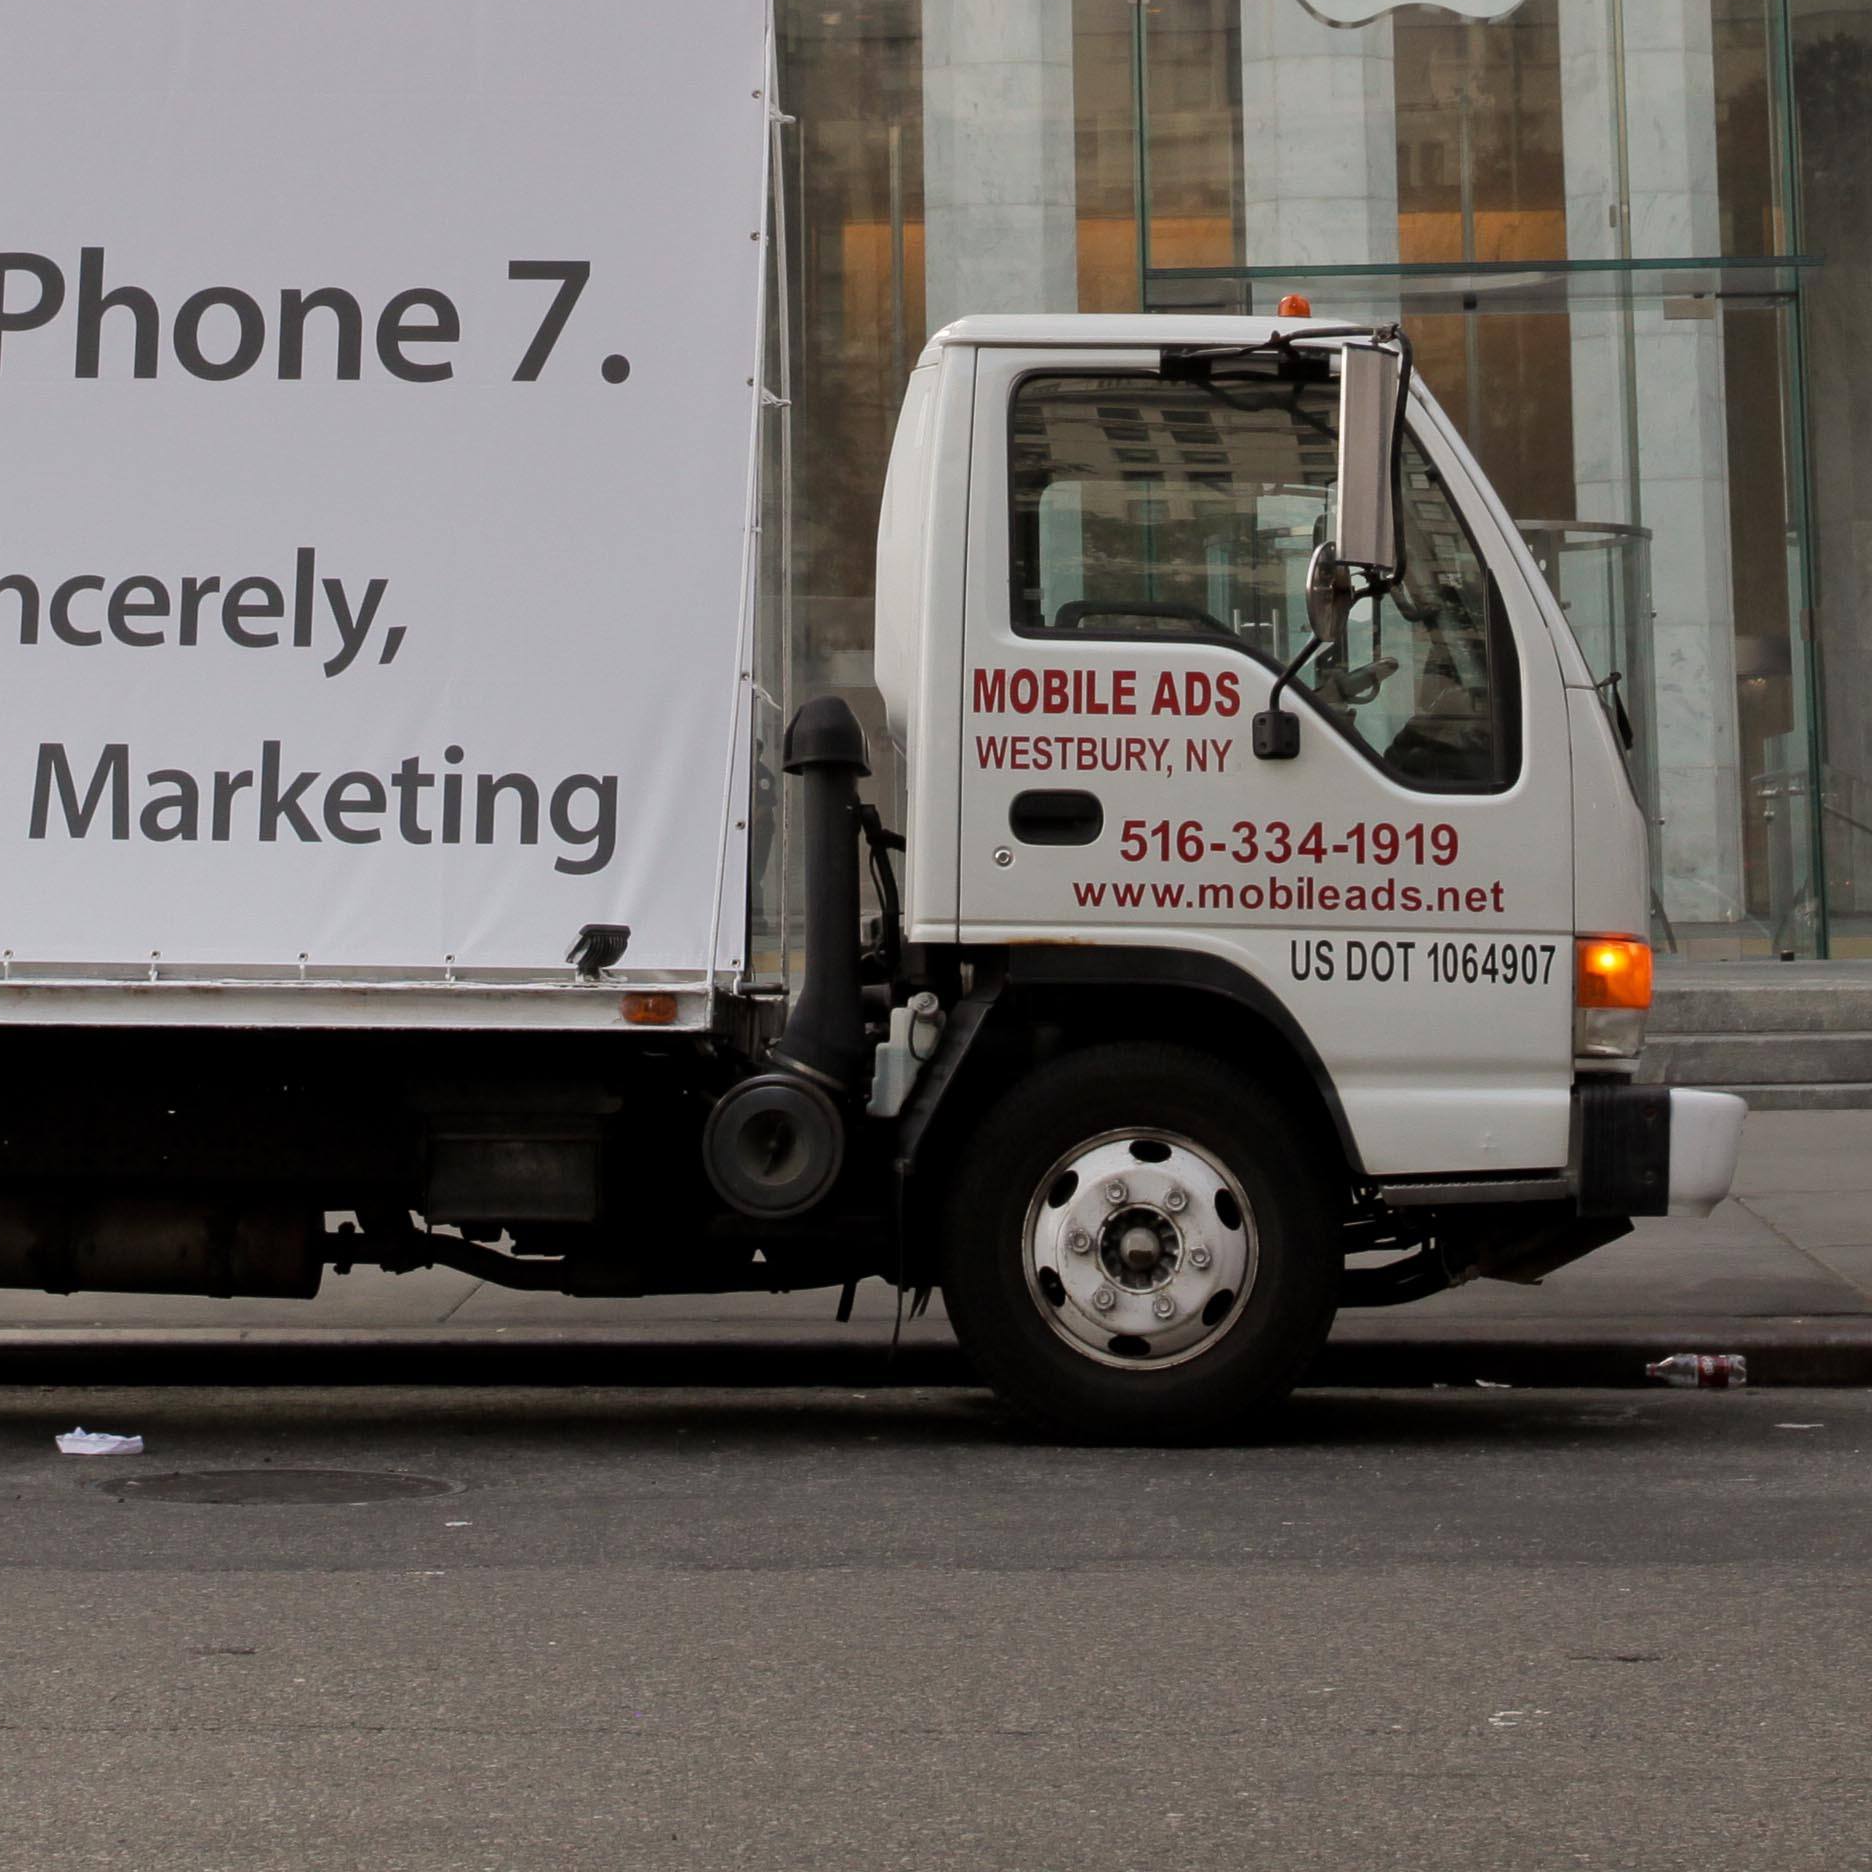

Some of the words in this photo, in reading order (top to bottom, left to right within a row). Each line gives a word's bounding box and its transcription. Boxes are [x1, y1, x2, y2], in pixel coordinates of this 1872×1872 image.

[507, 259, 632, 386] 7.
[972, 667, 1138, 716] MOBILE
[1150, 670, 1242, 719] ADS
[974, 734, 1174, 779] WESTBURY,
[1185, 737, 1234, 774] NY
[27, 739, 619, 877] Marketing
[1119, 818, 1460, 867] 516-334-1919
[1071, 875, 1506, 914] www.mobileads.net
[1290, 938, 1336, 983] US
[1345, 939, 1417, 984] DOT
[1426, 941, 1557, 986] 1064907
